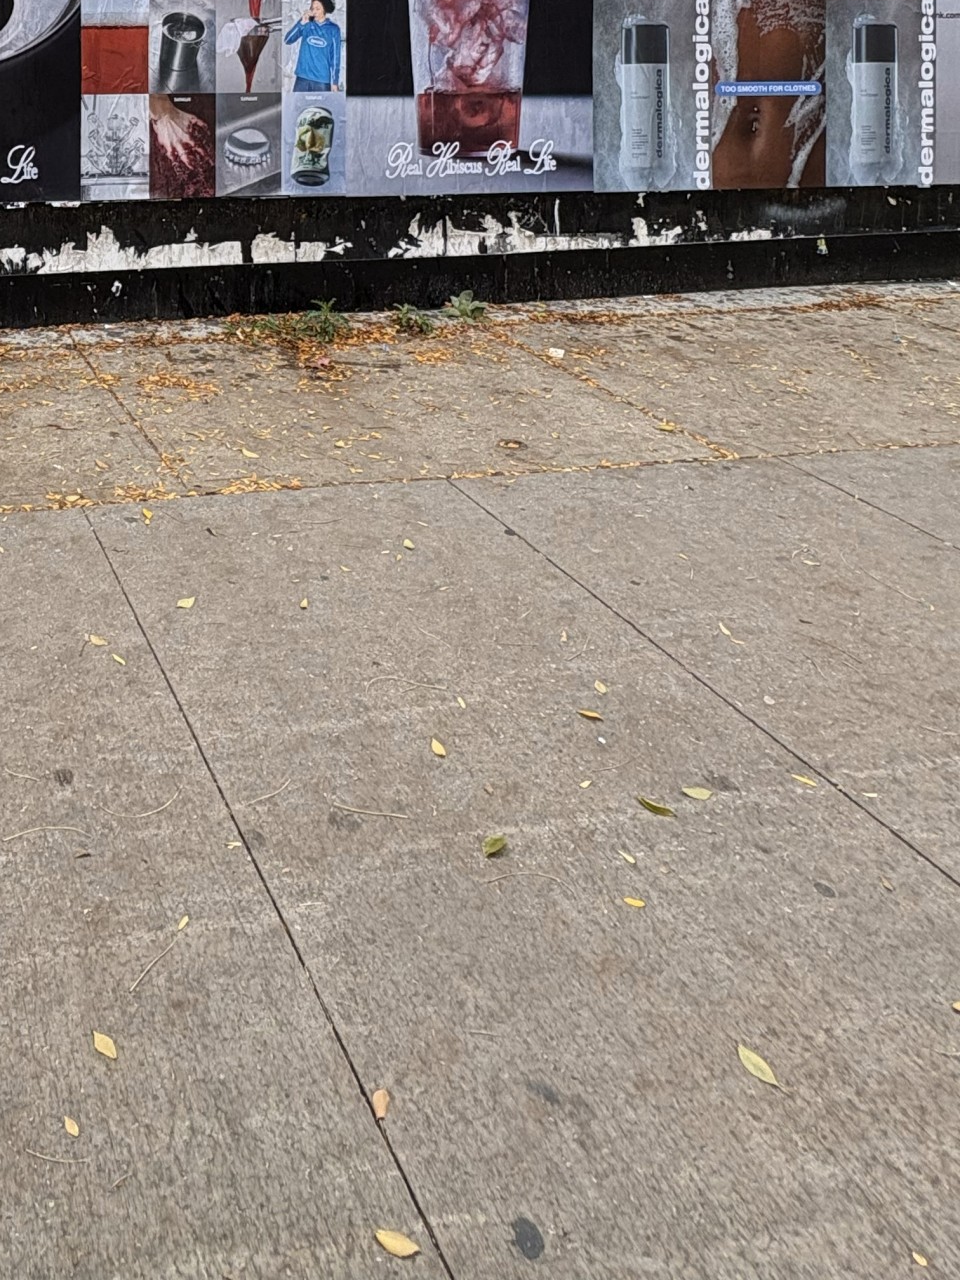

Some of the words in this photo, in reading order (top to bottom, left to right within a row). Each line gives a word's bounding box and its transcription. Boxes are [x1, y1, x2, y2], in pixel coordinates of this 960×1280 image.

[721, 85, 737, 93] TOO
[737, 85, 767, 93] SMOOTH
[784, 84, 817, 92] CLOTHES
[655, 69, 664, 158] dermalogica
[883, 67, 892, 154] dermalogica
[0, 144, 39, 184] Life
[385, 141, 423, 179] Real
[426, 141, 483, 178] Hibiscus
[484, 139, 521, 177] Real
[523, 138, 557, 175] Life
